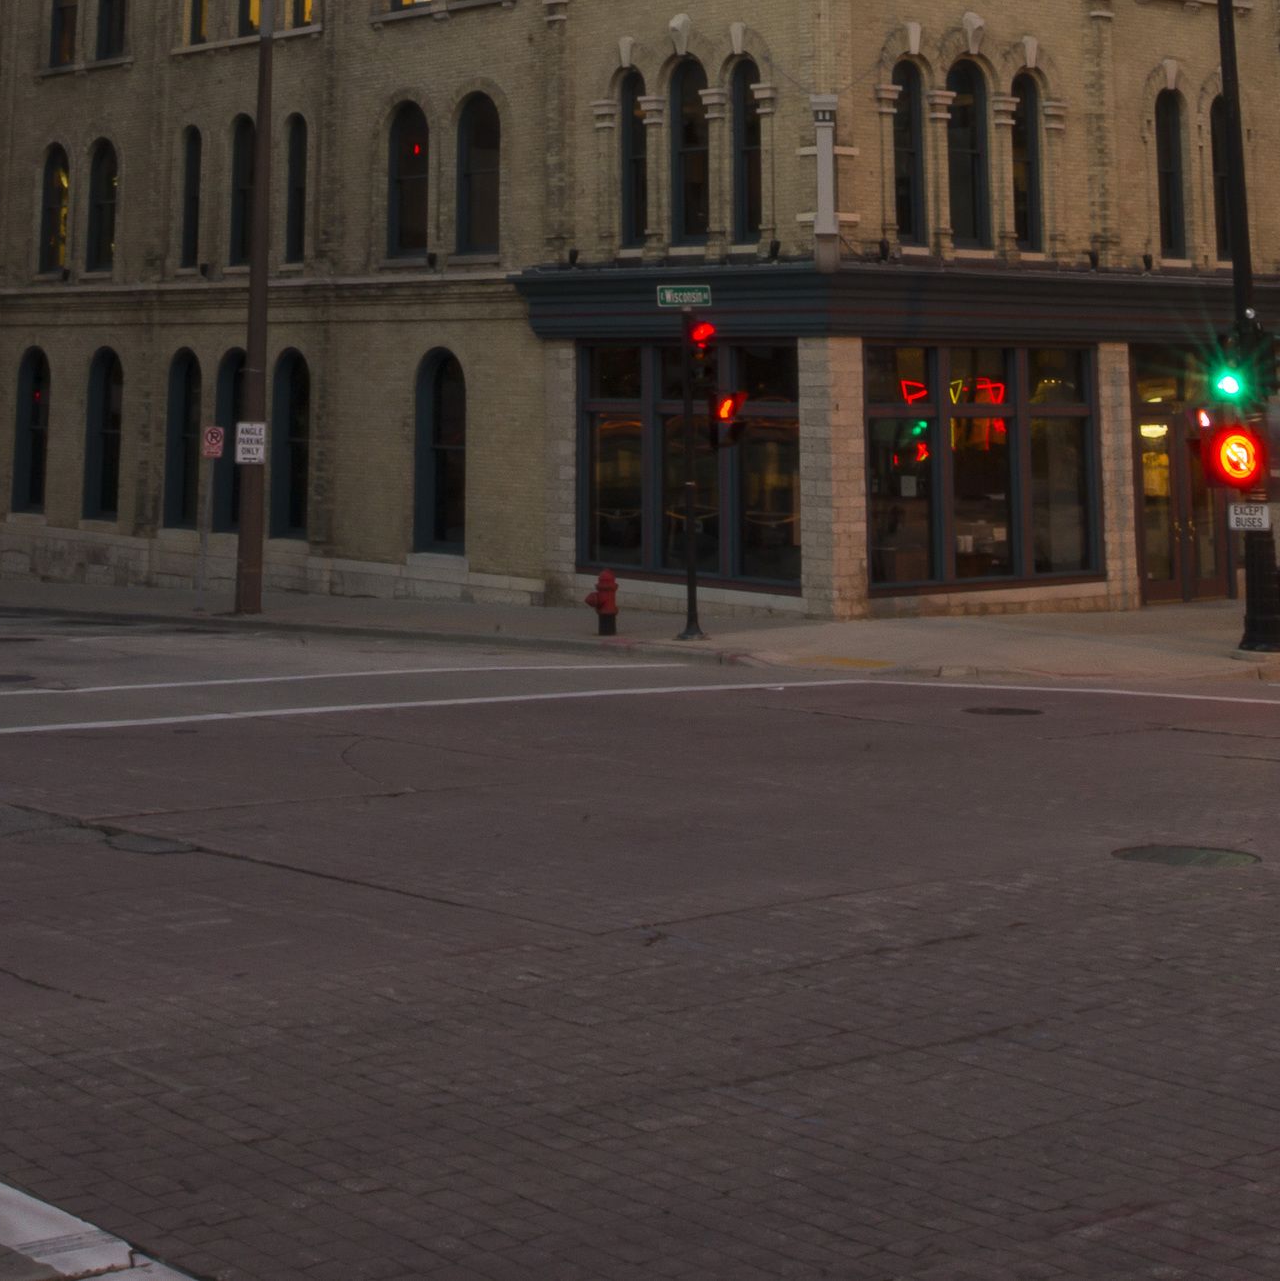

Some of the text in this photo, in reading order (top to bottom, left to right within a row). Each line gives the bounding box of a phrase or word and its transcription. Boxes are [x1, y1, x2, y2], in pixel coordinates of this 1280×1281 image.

[665, 289, 703, 303] Wisconsin
[240, 427, 263, 436] ANGLE
[239, 437, 264, 445] PARKING
[241, 447, 260, 455] ONLY
[1233, 505, 1264, 516] EXCEPT
[1235, 517, 1263, 527] BUSES
